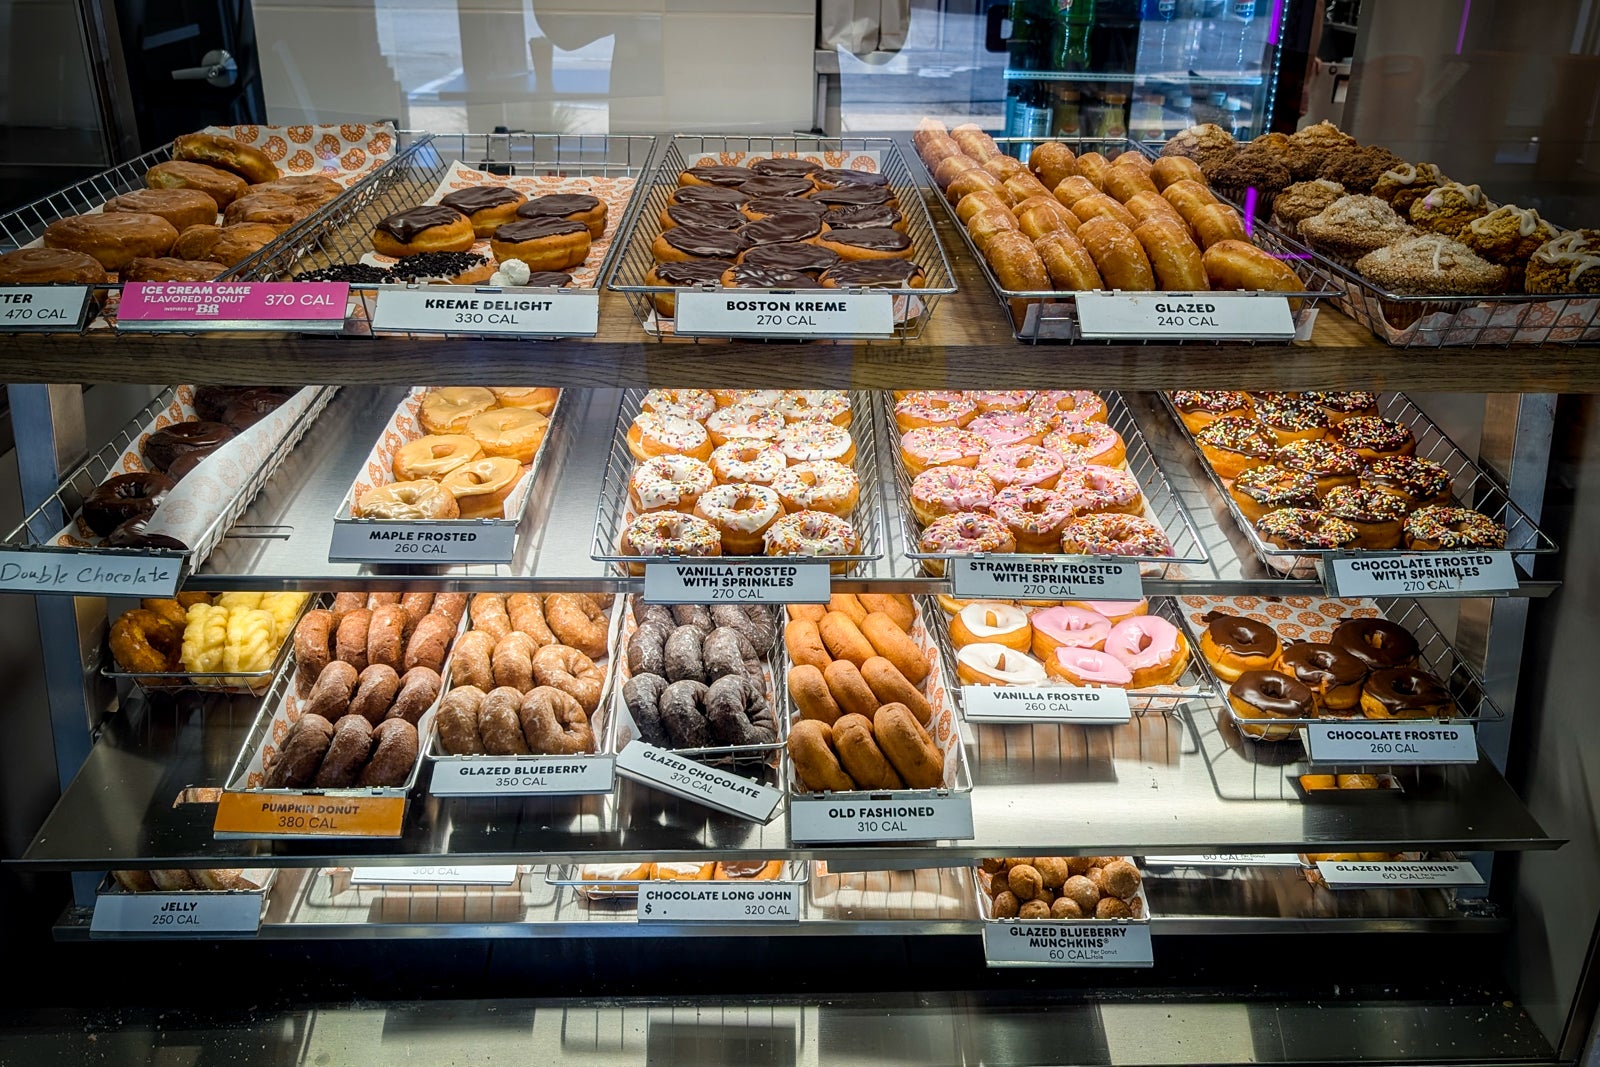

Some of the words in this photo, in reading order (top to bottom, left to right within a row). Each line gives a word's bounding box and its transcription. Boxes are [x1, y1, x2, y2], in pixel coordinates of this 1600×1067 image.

[142, 286, 163, 295] ICE
[166, 286, 213, 295] CREAM
[216, 286, 251, 295] CAKE
[0, 294, 33, 304] TER
[144, 295, 202, 303] FLAVORED
[204, 295, 245, 303] DONUT
[264, 294, 295, 306] 370
[300, 294, 335, 306] CAL
[425, 299, 479, 310] KREME
[483, 300, 552, 311] DELIGHT
[726, 301, 790, 312] BOSTON
[795, 301, 847, 312] KREME
[1155, 303, 1216, 313] GLAZED
[5, 308, 33, 319] 470
[37, 308, 67, 319] CAL
[455, 313, 483, 323] 330
[487, 313, 519, 324] CAL
[756, 315, 782, 325] 270
[786, 315, 816, 326] CAL
[1157, 316, 1185, 326] 240
[1188, 316, 1219, 326] CAL
[369, 531, 415, 541] MAPLE
[417, 532, 477, 542] FROSTED
[394, 543, 419, 553] 260
[421, 544, 447, 554] CAL
[970, 562, 1058, 573] STRAWBERRY
[1062, 564, 1122, 575] FROSTED
[1351, 558, 1432, 571] CHOCOLATE
[1435, 555, 1493, 567] FROSTED
[0, 562, 69, 586] Double
[77, 566, 170, 585] Chocolate
[676, 566, 733, 577] VANILLA
[737, 566, 797, 577] FROSTED
[1372, 570, 1407, 581] WITH
[1410, 567, 1480, 580] SPRINKLES
[683, 577, 718, 587] WITH
[722, 577, 794, 587] SPRINKLES
[993, 573, 1028, 583] WITH
[1032, 574, 1105, 585] SPRINKLES
[1023, 585, 1046, 594] 270
[1049, 585, 1076, 595] CAL
[1403, 581, 1425, 591] 270
[1428, 580, 1454, 590] CAL
[712, 589, 734, 599] 270
[737, 589, 764, 599] CAL
[993, 691, 1044, 701] VANILLA
[1047, 693, 1100, 701] FROSTED
[1024, 702, 1046, 711] 260
[1049, 703, 1072, 712] CAL
[1327, 730, 1402, 740] CHOCOLATE
[1404, 731, 1459, 740] FROSTED
[1370, 743, 1392, 753] 260
[1395, 743, 1419, 753] CAL
[459, 767, 511, 776] GLAZED
[514, 765, 588, 775] BLUEBERRY
[643, 750, 687, 771] GLAZED
[688, 767, 760, 799] CHOCOLATE
[495, 777, 519, 787] 350
[522, 777, 548, 786] CAL
[670, 772, 691, 785] 370
[691, 780, 713, 795] CAL
[261, 803, 315, 813] PUMPKIN
[317, 805, 360, 815] DONUT
[828, 808, 856, 818] OLD
[859, 807, 935, 817] FASHIONED
[278, 816, 304, 828] 380
[308, 817, 338, 829] CAL
[857, 821, 878, 832] 310
[881, 821, 908, 832] CAL
[437, 867, 460, 876] CAL
[646, 891, 719, 901] CHOCOLATE
[721, 891, 755, 901] LONG
[757, 891, 792, 901] JOHN
[161, 902, 198, 912] JELLY
[644, 903, 652, 914] $
[744, 905, 765, 915] 320
[768, 905, 791, 915] CAL
[152, 915, 174, 925] 250
[176, 915, 200, 925] CAL
[1010, 927, 1057, 937] GLAZED
[1060, 927, 1127, 938] BLUEBERRY
[1050, 950, 1065, 960] 60
[1067, 950, 1091, 960] CAL
